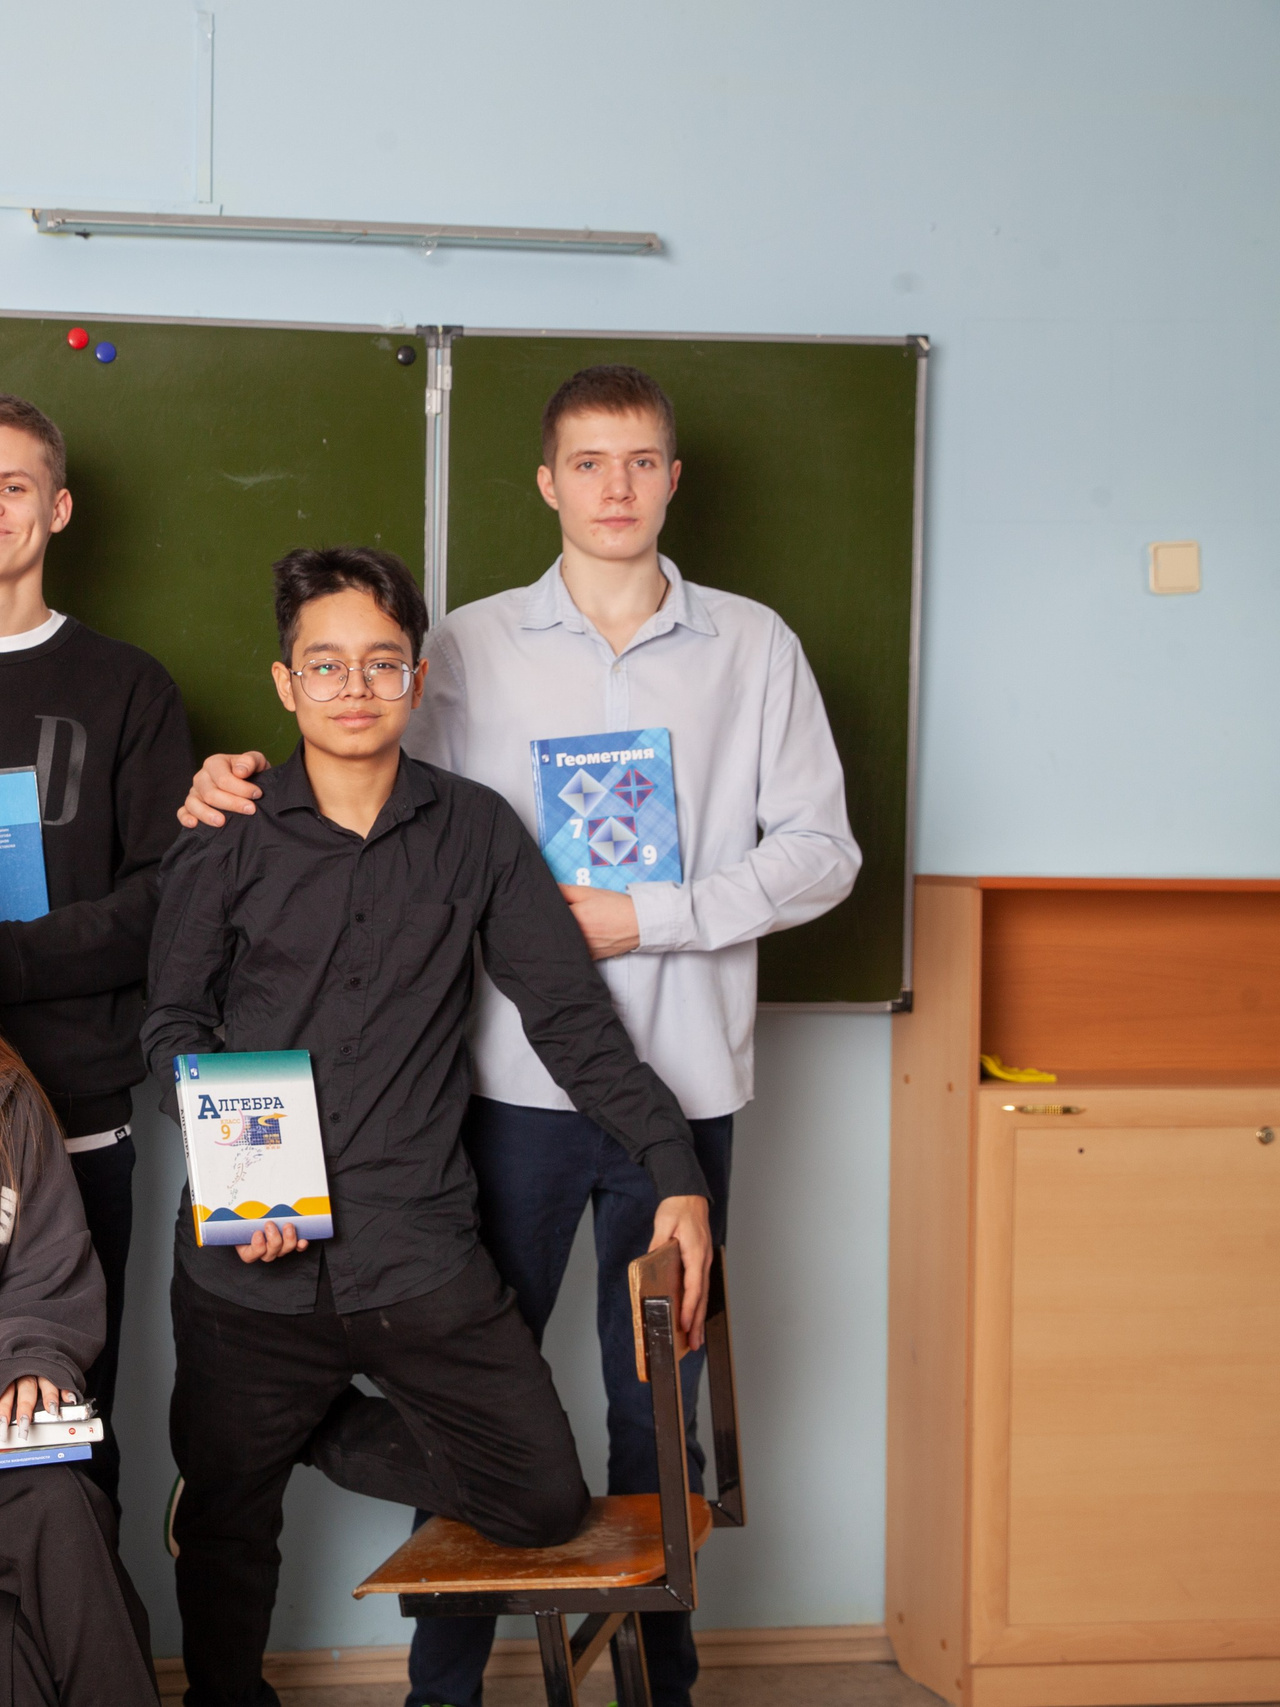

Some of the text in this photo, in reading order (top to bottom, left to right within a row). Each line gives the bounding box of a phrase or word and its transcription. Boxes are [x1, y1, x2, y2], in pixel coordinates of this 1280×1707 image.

[556, 748, 654, 767] Геометрия
[570, 819, 583, 839] 7
[642, 845, 657, 865] 9
[576, 868, 591, 886] 8
[198, 1094, 284, 1119] АЛГЕБРА
[221, 1124, 231, 1140] 9
